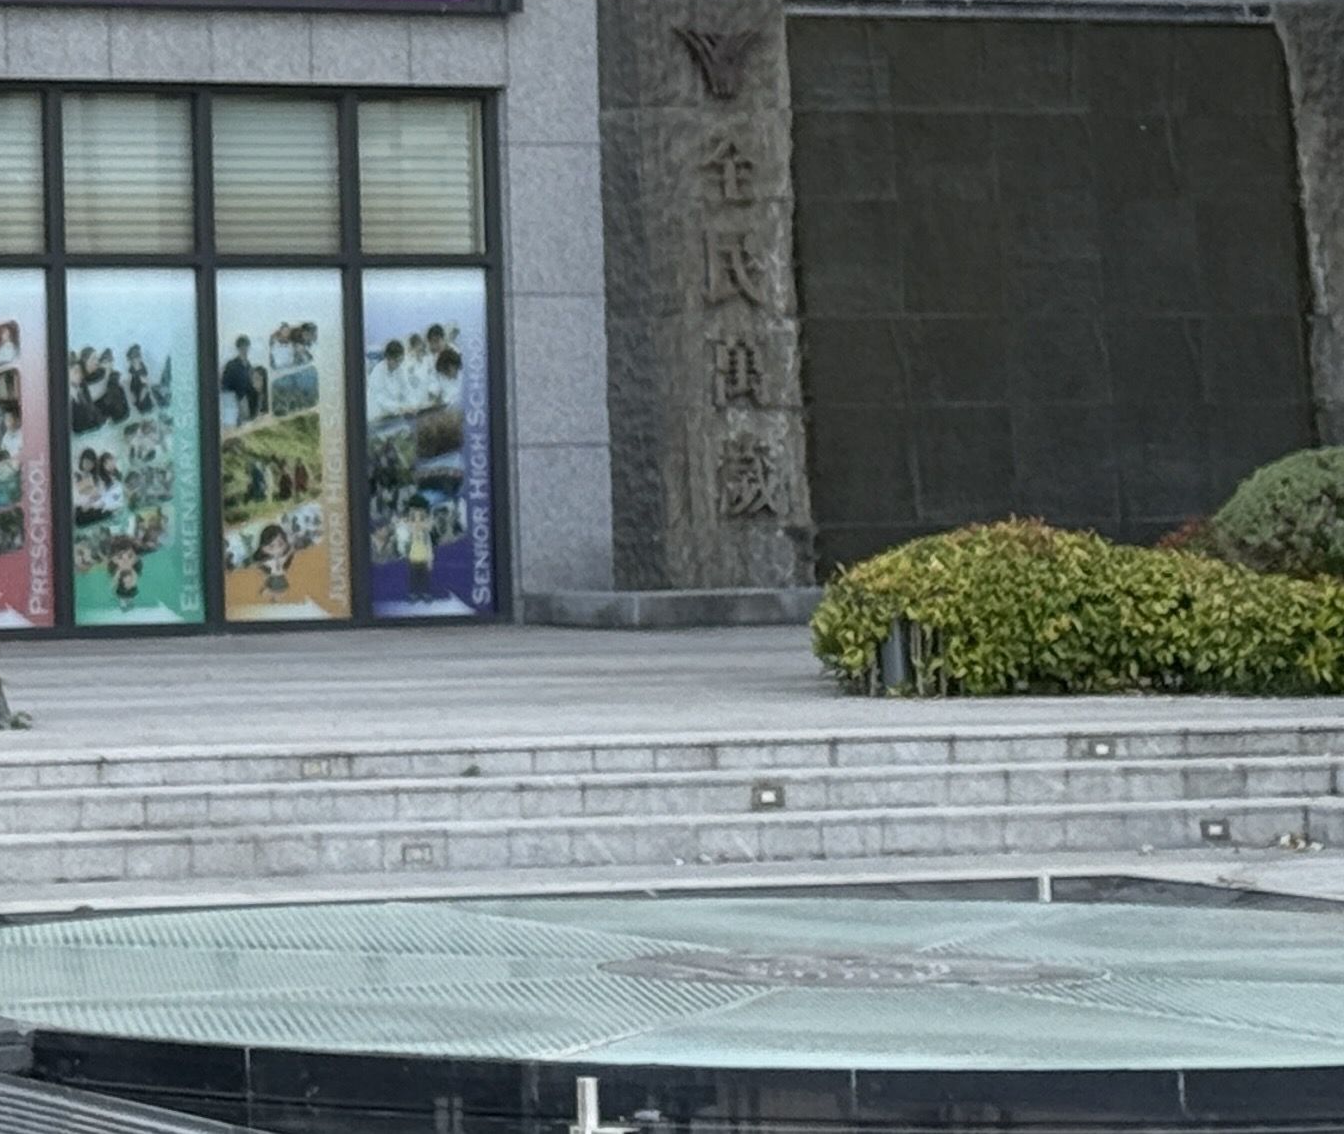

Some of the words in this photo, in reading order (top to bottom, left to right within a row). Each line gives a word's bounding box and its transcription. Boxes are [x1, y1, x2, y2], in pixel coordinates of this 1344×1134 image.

[325, 436, 344, 505] HIGH
[468, 432, 489, 501] HIGH
[28, 454, 49, 615] PRESCHOOL
[178, 434, 201, 612] ELEMENTARY
[328, 511, 348, 602] JUNIOR
[472, 506, 492, 606] SENIOR
